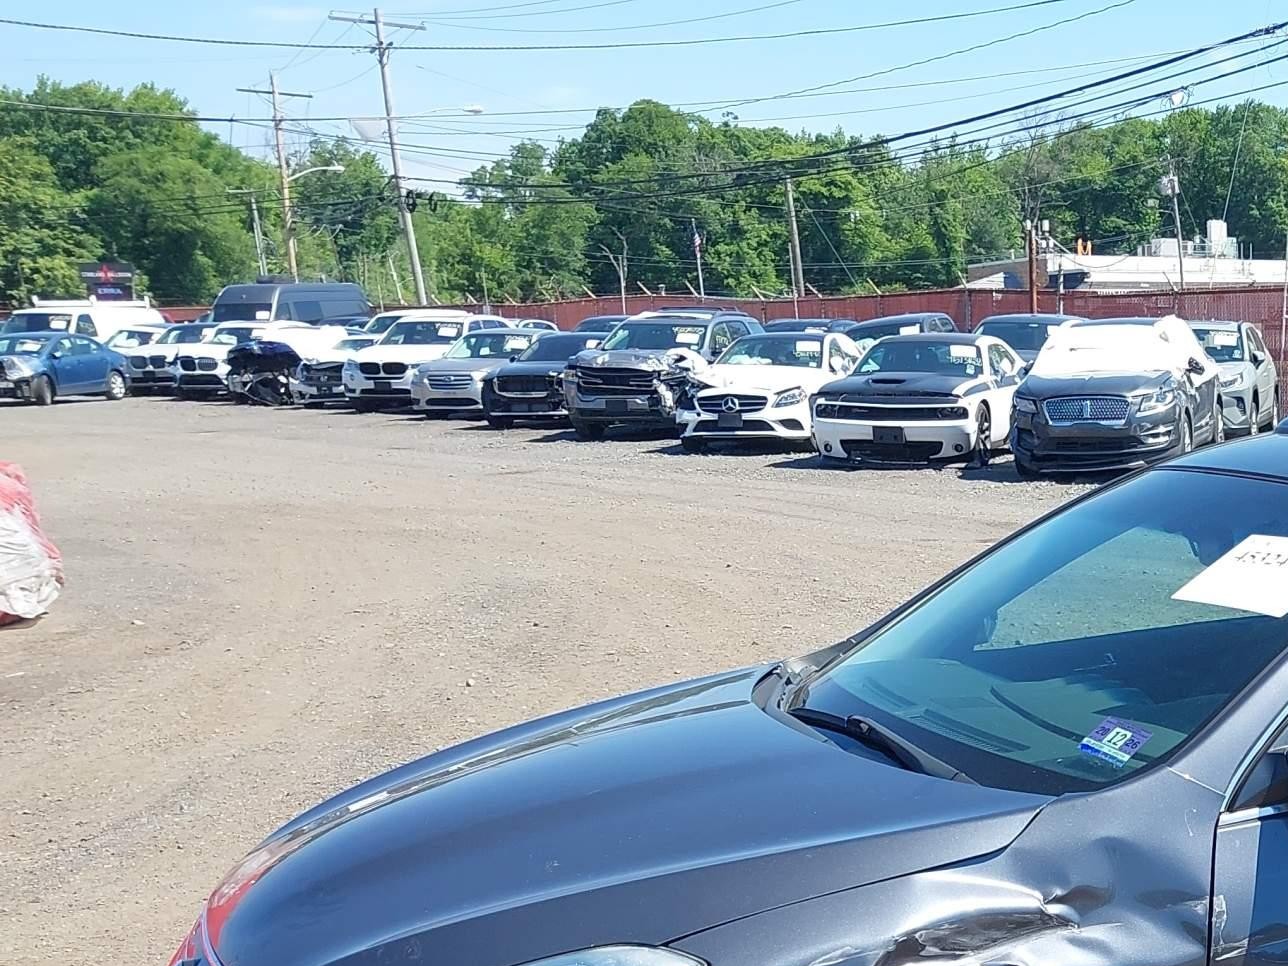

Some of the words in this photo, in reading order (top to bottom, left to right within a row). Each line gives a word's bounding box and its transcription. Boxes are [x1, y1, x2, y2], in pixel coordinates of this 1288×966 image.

[1095, 726, 1111, 736] 20
[1107, 731, 1128, 746] 12
[1125, 738, 1141, 749] 26
